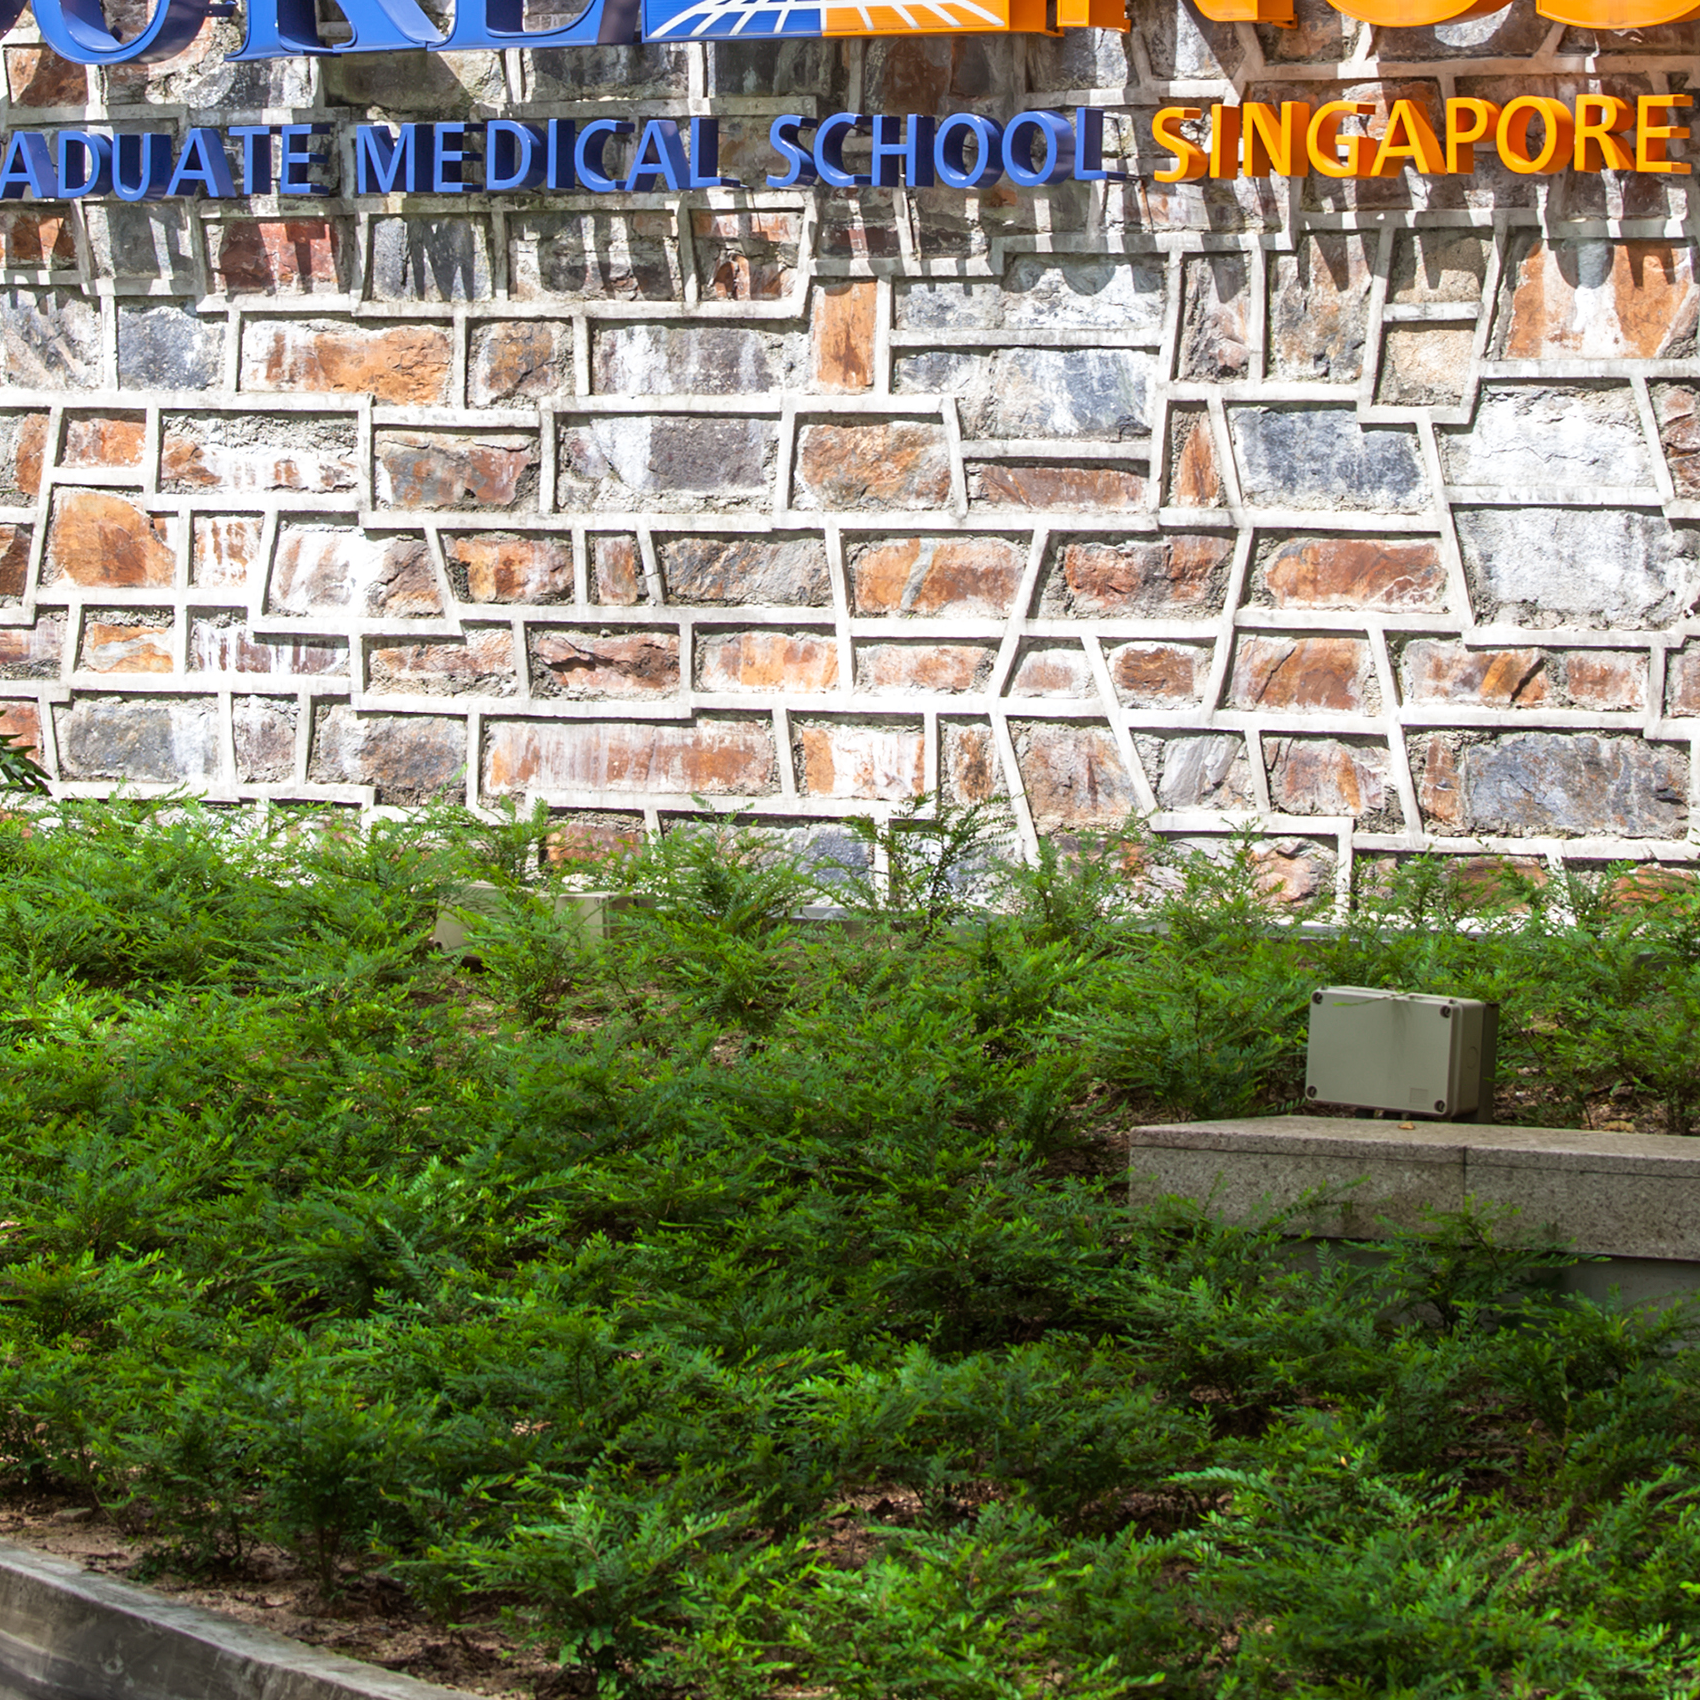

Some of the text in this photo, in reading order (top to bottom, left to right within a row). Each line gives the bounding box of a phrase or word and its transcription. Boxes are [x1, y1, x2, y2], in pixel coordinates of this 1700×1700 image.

[356, 116, 740, 195] MEDICAL
[766, 106, 1127, 189] SCHOOL
[1152, 93, 1694, 184] SINGAPORE
